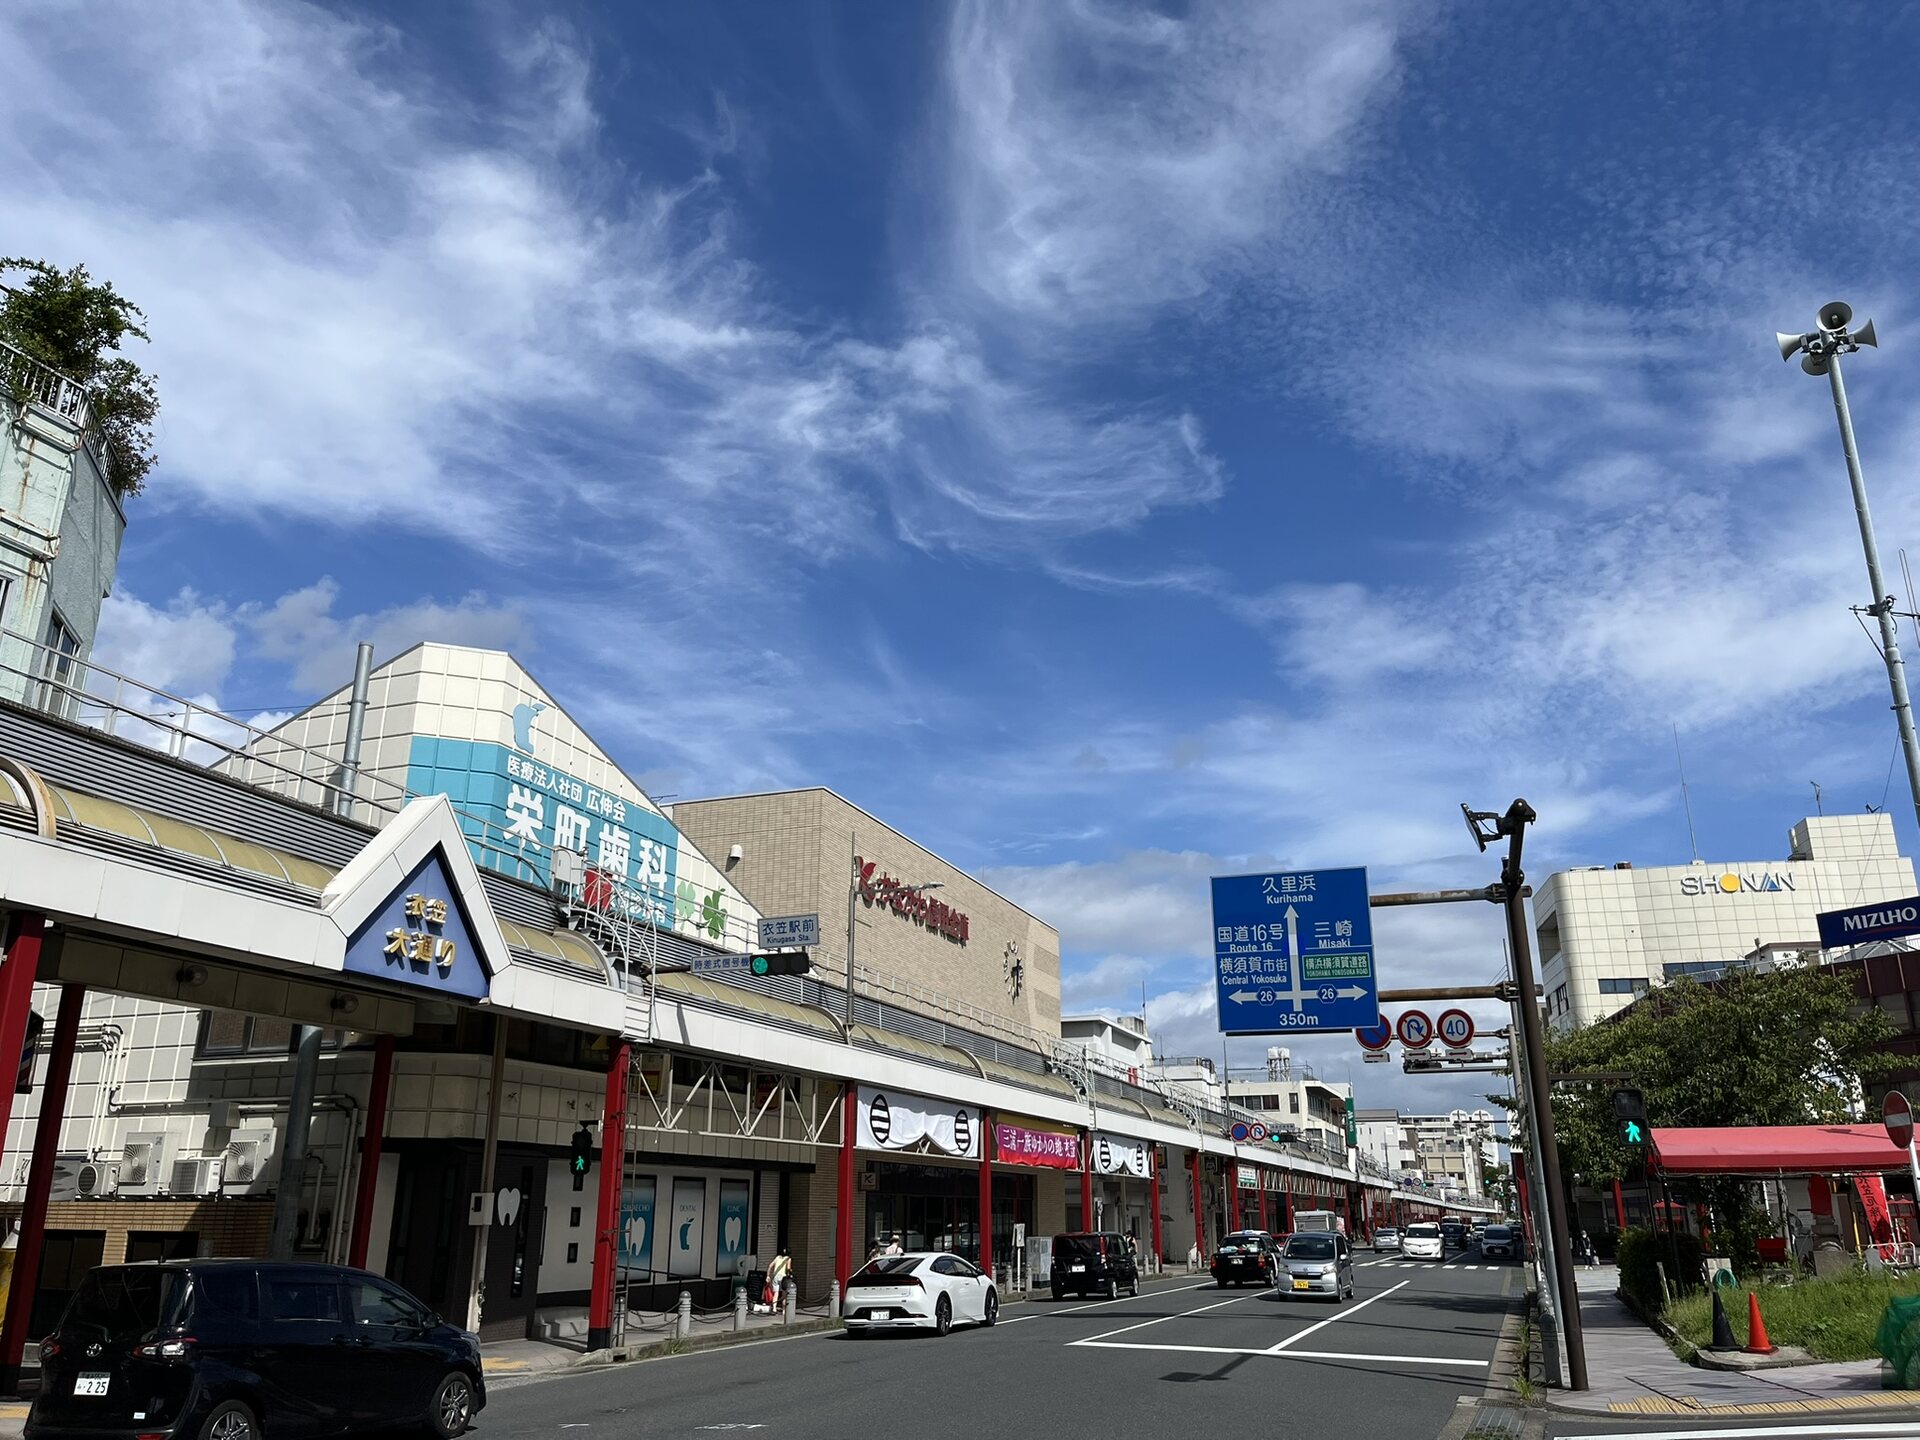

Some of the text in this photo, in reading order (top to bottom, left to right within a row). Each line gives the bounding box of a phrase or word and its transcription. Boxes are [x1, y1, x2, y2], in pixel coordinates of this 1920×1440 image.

[507, 754, 627, 824] 医療法人社団 広伸会
[502, 783, 668, 898] 栄町歯科
[1262, 874, 1317, 894] 久里浜
[1680, 871, 1796, 896] SHONAN
[1266, 893, 1314, 905] Kurihama
[405, 893, 448, 924] 衣笠
[762, 919, 814, 937] 衣笠駅前
[1314, 919, 1353, 938] 三崎
[1843, 906, 1917, 934] MIZUHO
[766, 934, 811, 945] Kinugasa Sta.
[1218, 923, 1285, 943] 国道16号
[383, 927, 456, 967] 大通り
[1229, 942, 1273, 952] Route 16
[1318, 938, 1351, 948] Misaki
[694, 957, 750, 971] 時差式信号機
[1219, 955, 1288, 975] 横須賀市街
[1305, 955, 1368, 970] 横浜横須賀道路
[1222, 973, 1287, 986] Central Yokosuka
[1260, 990, 1273, 1002] 26
[1321, 988, 1334, 1000] 26
[1279, 1012, 1319, 1027] 350m
[1446, 1018, 1466, 1037] 40
